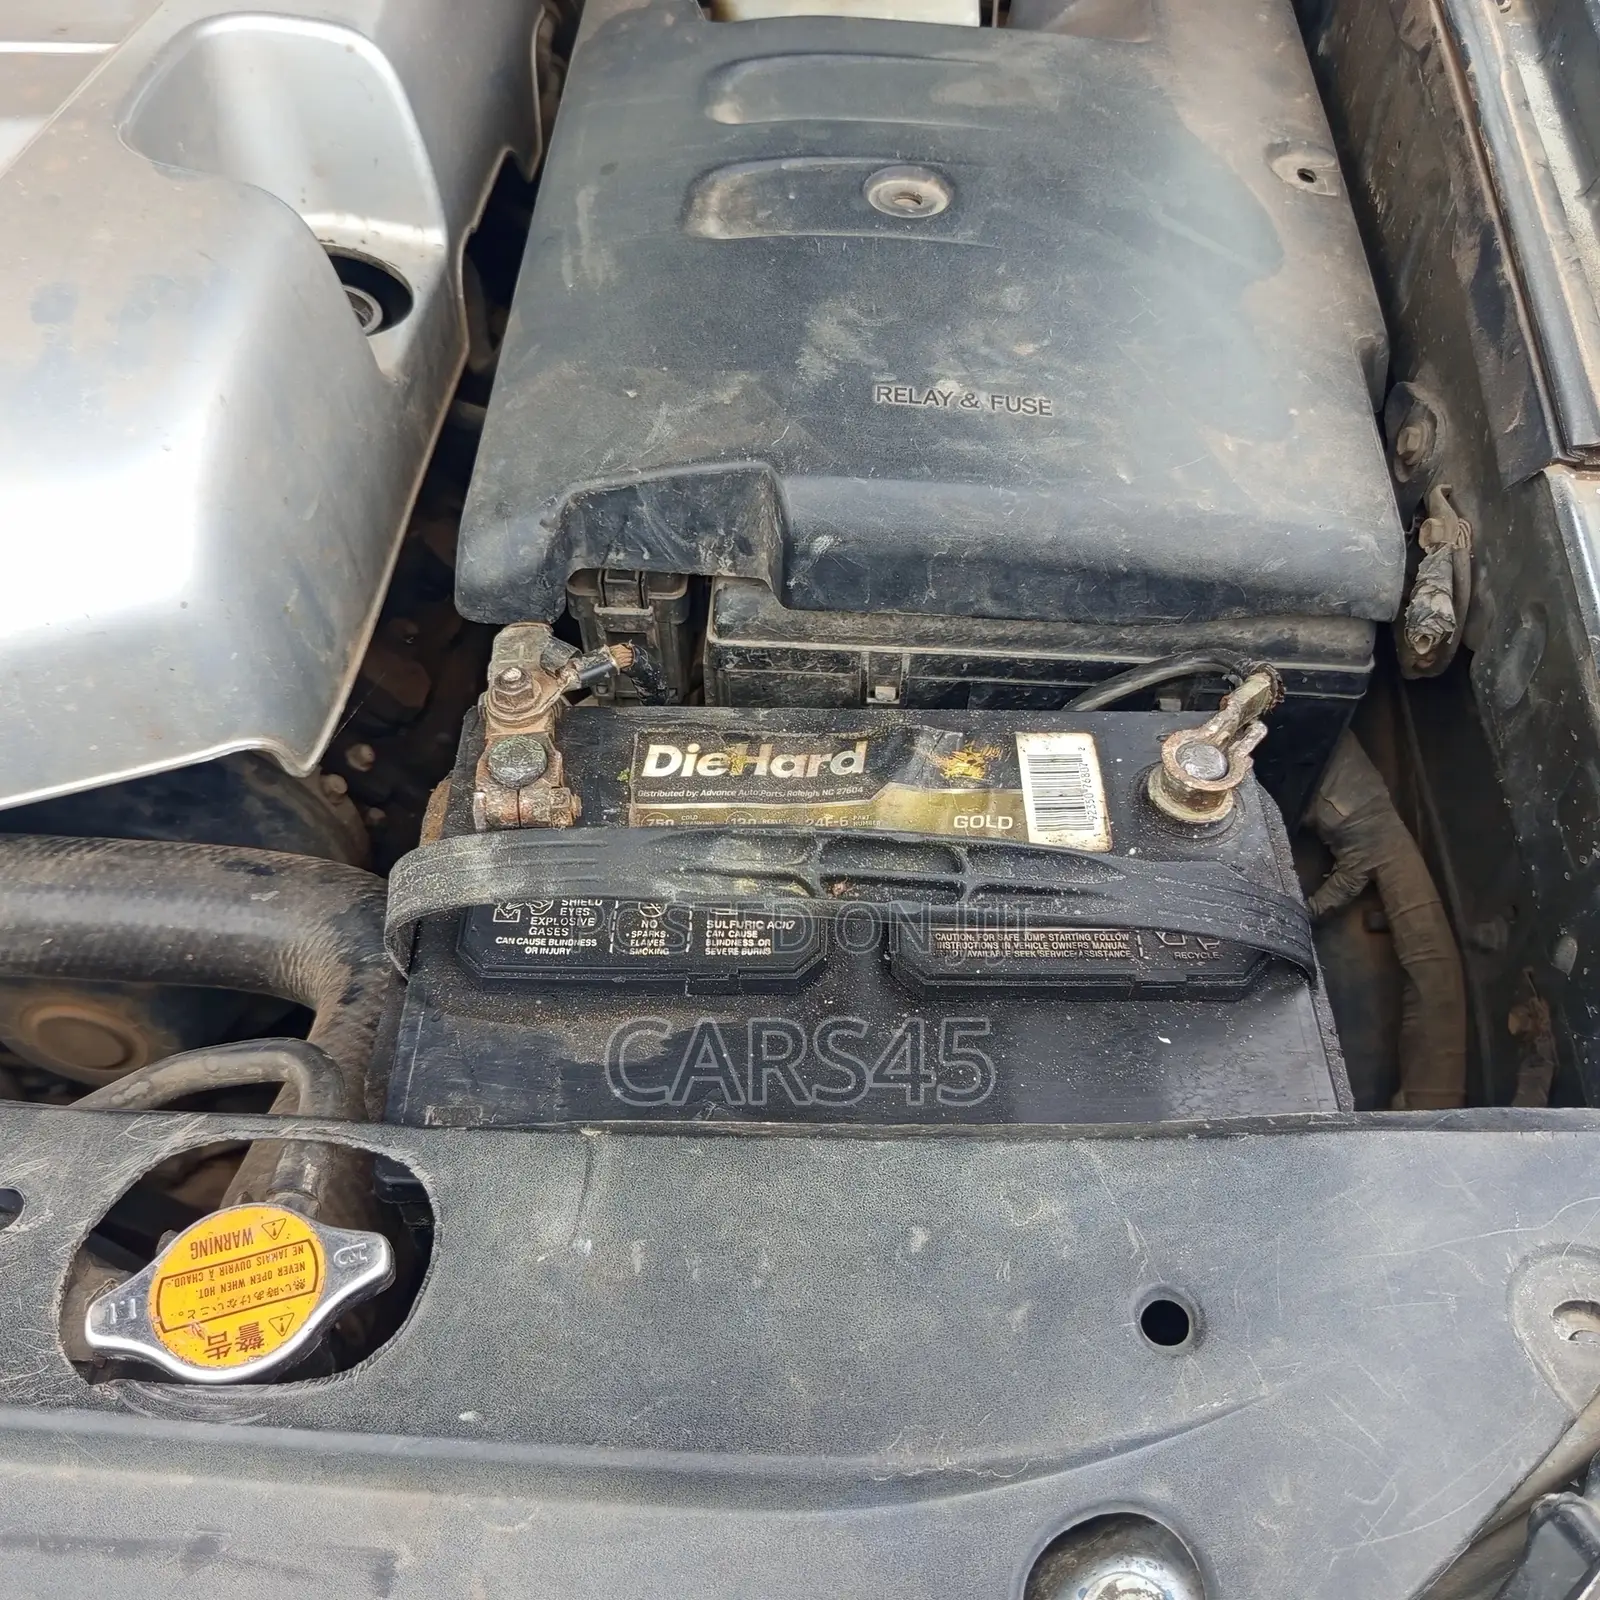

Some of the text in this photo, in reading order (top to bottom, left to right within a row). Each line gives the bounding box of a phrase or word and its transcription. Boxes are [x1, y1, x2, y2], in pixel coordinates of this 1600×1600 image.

[875, 384, 1054, 416] RELAY & FUSE
[641, 741, 868, 778] DieHard
[1078, 762, 1092, 789] 76807
[637, 789, 685, 797] Distributed
[700, 789, 737, 797] Advance
[738, 789, 759, 797] Auto
[822, 788, 835, 796] NC
[1083, 792, 1098, 822] 92350
[953, 815, 1014, 830] GOLD
[560, 908, 590, 916] EYES
[530, 917, 596, 927] EXPLOSIVE
[641, 919, 658, 929] NO
[706, 920, 764, 930] SULFURIC
[529, 927, 569, 936] GASES
[705, 930, 758, 938] CAN CAUSE
[495, 936, 598, 947] CAN CAUSE BLINDNESS
[976, 933, 995, 941] FOR
[997, 933, 1019, 941] SAFE
[1024, 933, 1046, 941] JUMP
[1048, 933, 1091, 941] STARTING
[1093, 933, 1130, 941] FOLLOW
[630, 939, 665, 947] FLAMES
[705, 938, 771, 947] BLINDNESS OR
[936, 941, 999, 949] INSTRUCTIONS
[1014, 942, 1049, 950] VEHICLE
[1051, 941, 1089, 950] OWNERS
[524, 946, 572, 955] OR INJURY
[629, 947, 670, 956] SMOKING
[705, 947, 772, 956] SEVERE BURNS
[967, 950, 1012, 958] AVAILABLE
[1014, 950, 1036, 958] SEEK
[1038, 950, 1076, 958] SERVICE
[190, 1227, 254, 1260] WARNING
[292, 1244, 305, 1256] NE
[256, 1248, 288, 1267] JAMAIS
[219, 1259, 252, 1277] OUVRIR
[277, 1261, 306, 1277] NEVER
[250, 1270, 273, 1286] OPEN
[220, 1278, 246, 1294] WHEN
[203, 1321, 265, 1360] 警告
